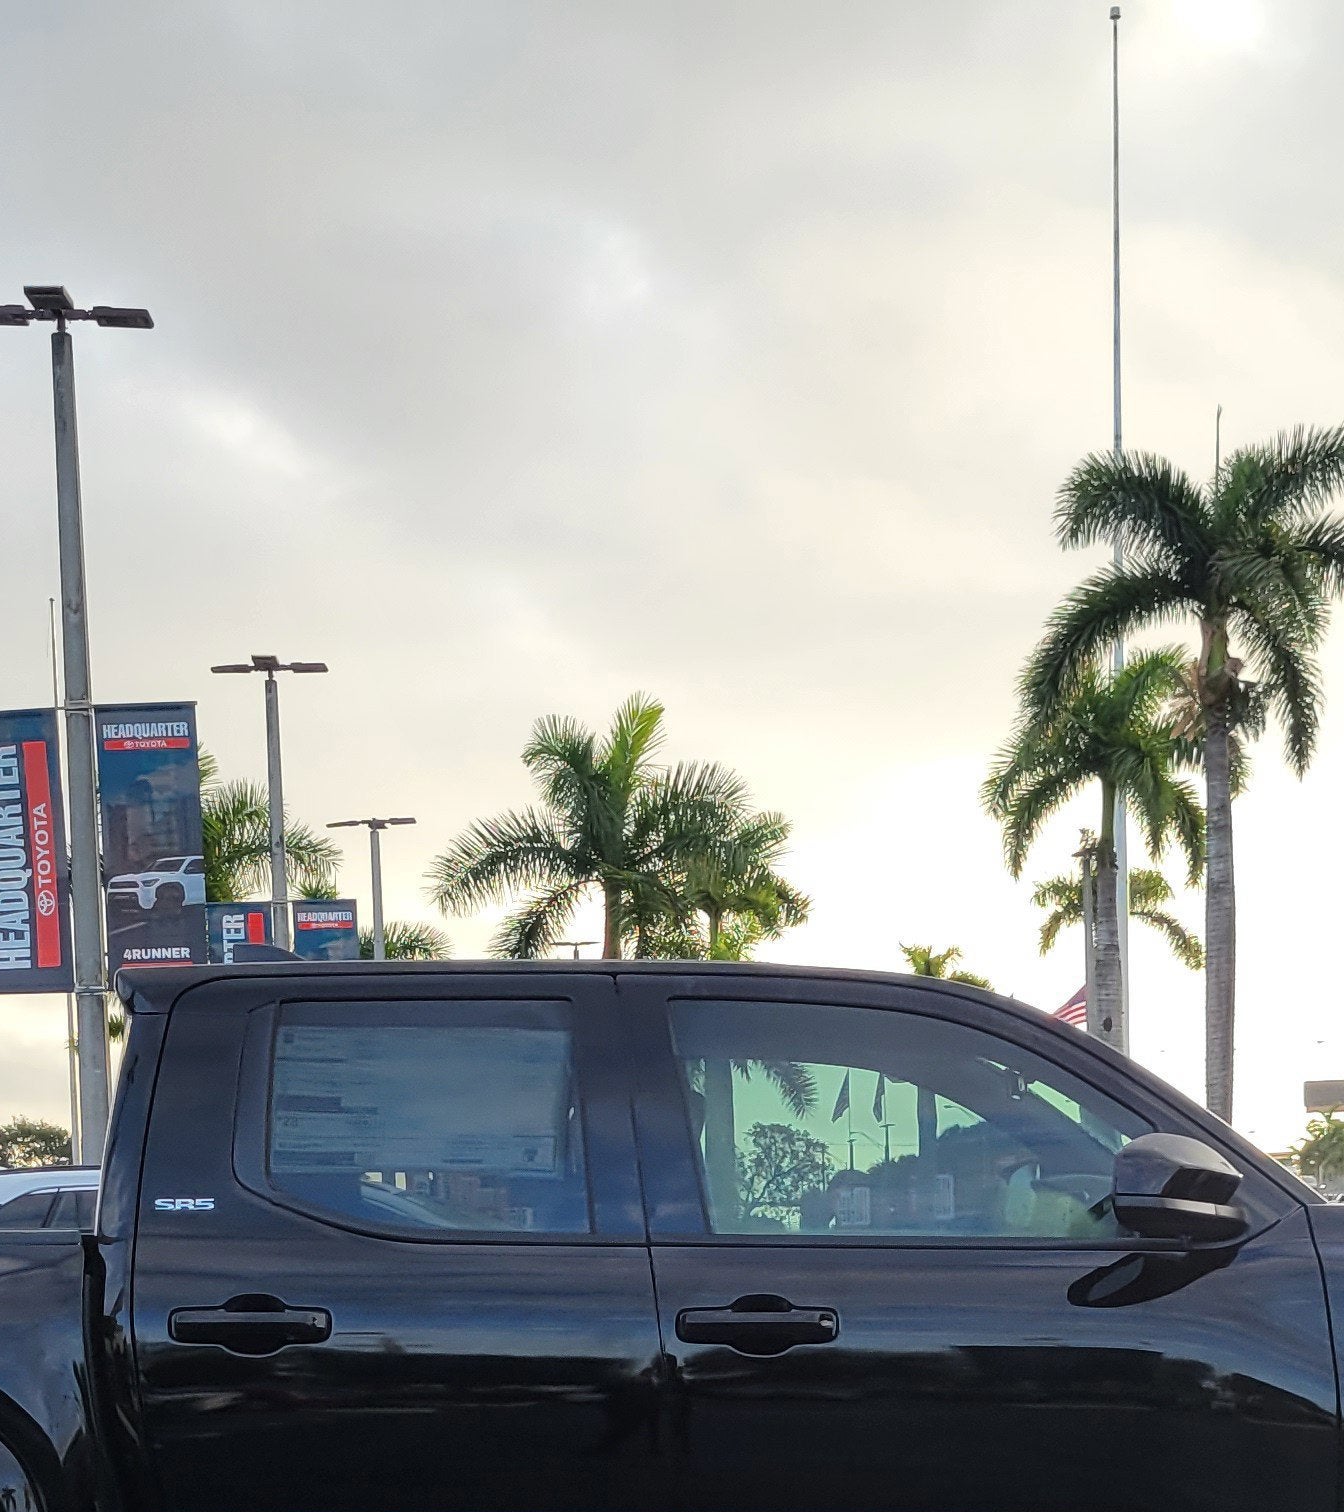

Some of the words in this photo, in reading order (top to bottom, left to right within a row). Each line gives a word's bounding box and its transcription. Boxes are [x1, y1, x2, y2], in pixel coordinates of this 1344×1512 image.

[102, 721, 189, 741] HEADQUARTER
[134, 739, 167, 750] TOYOTA
[32, 802, 55, 888] TOYOTA
[297, 911, 353, 923] HEADQUARTER
[122, 946, 192, 962] 4RUNNER
[154, 1197, 215, 1211] SR5
